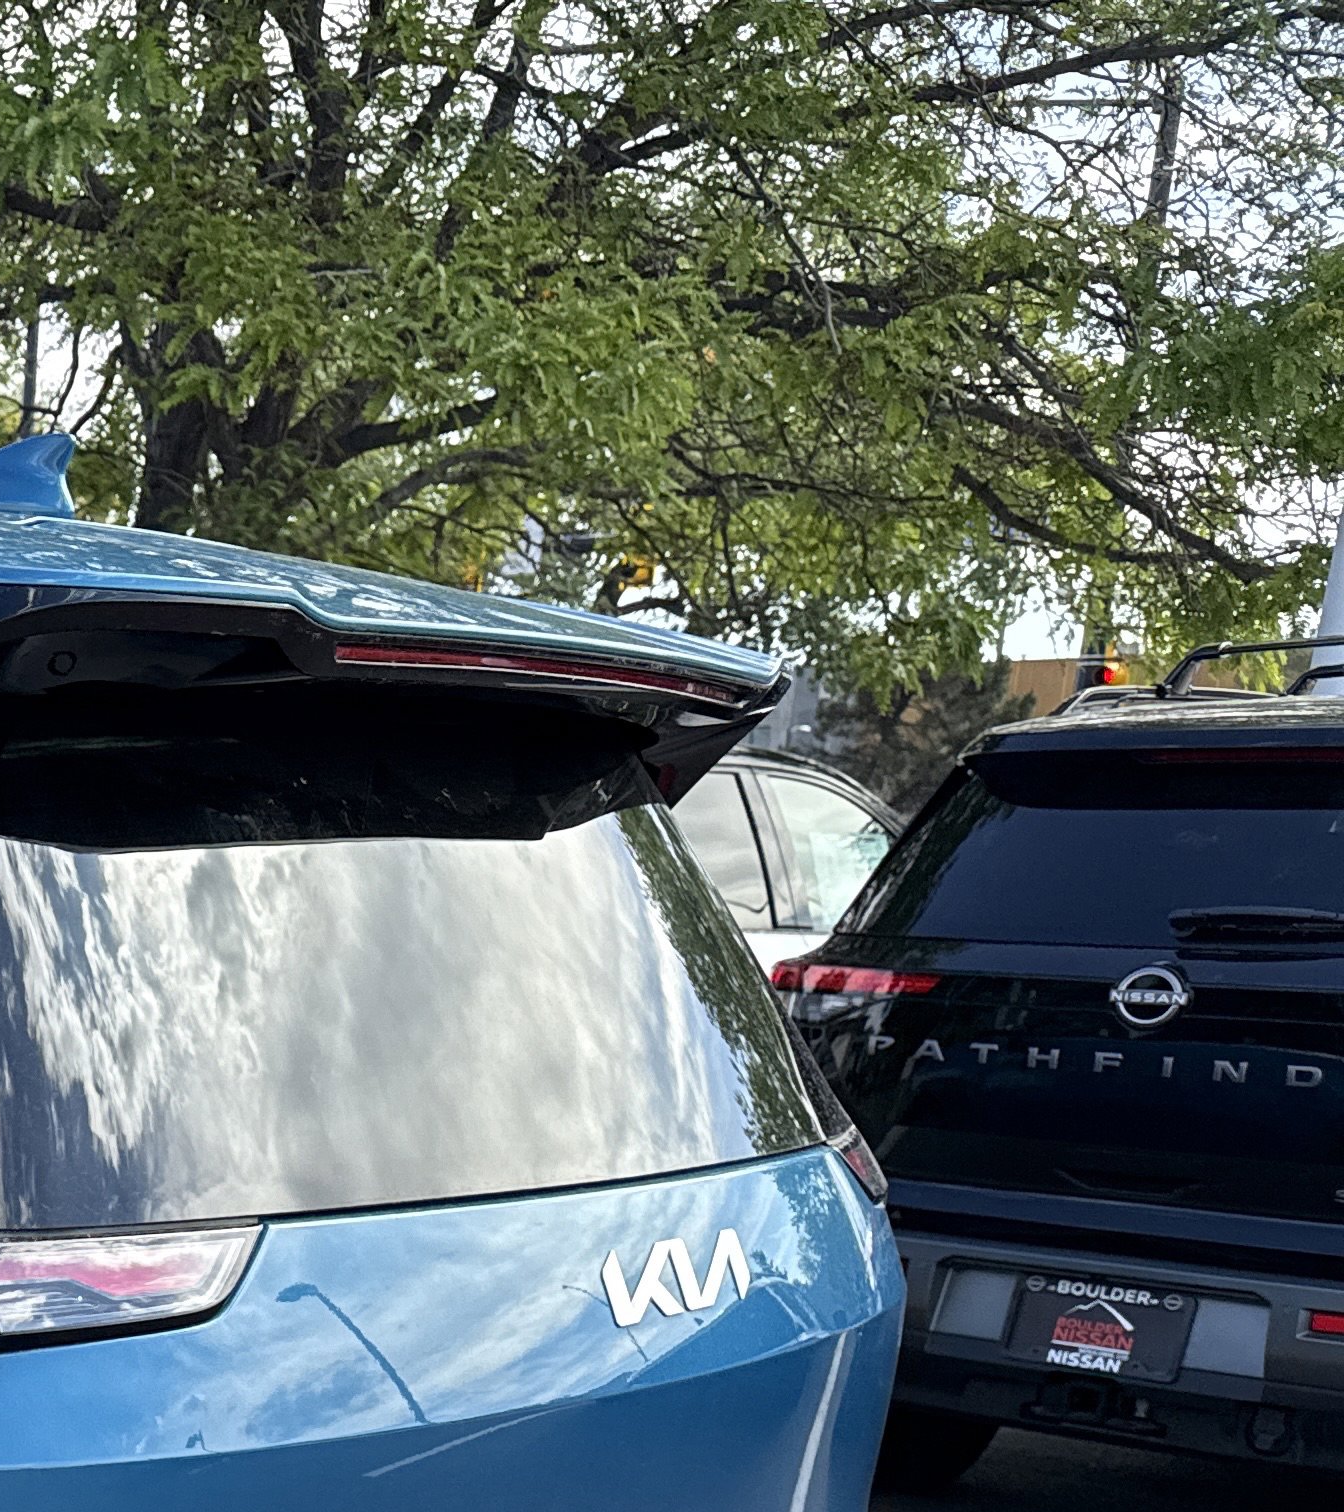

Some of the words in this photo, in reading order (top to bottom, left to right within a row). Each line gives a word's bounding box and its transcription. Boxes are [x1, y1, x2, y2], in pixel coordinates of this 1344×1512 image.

[1110, 989, 1187, 1005] NISSAN
[868, 1035, 1323, 1088] PATHFIND
[601, 1227, 751, 1328] KIA
[1057, 1279, 1152, 1305] BOULDER
[1056, 1316, 1123, 1333] BOULDER
[1052, 1327, 1134, 1352] NISSAN
[1046, 1349, 1121, 1373] NISSAN
